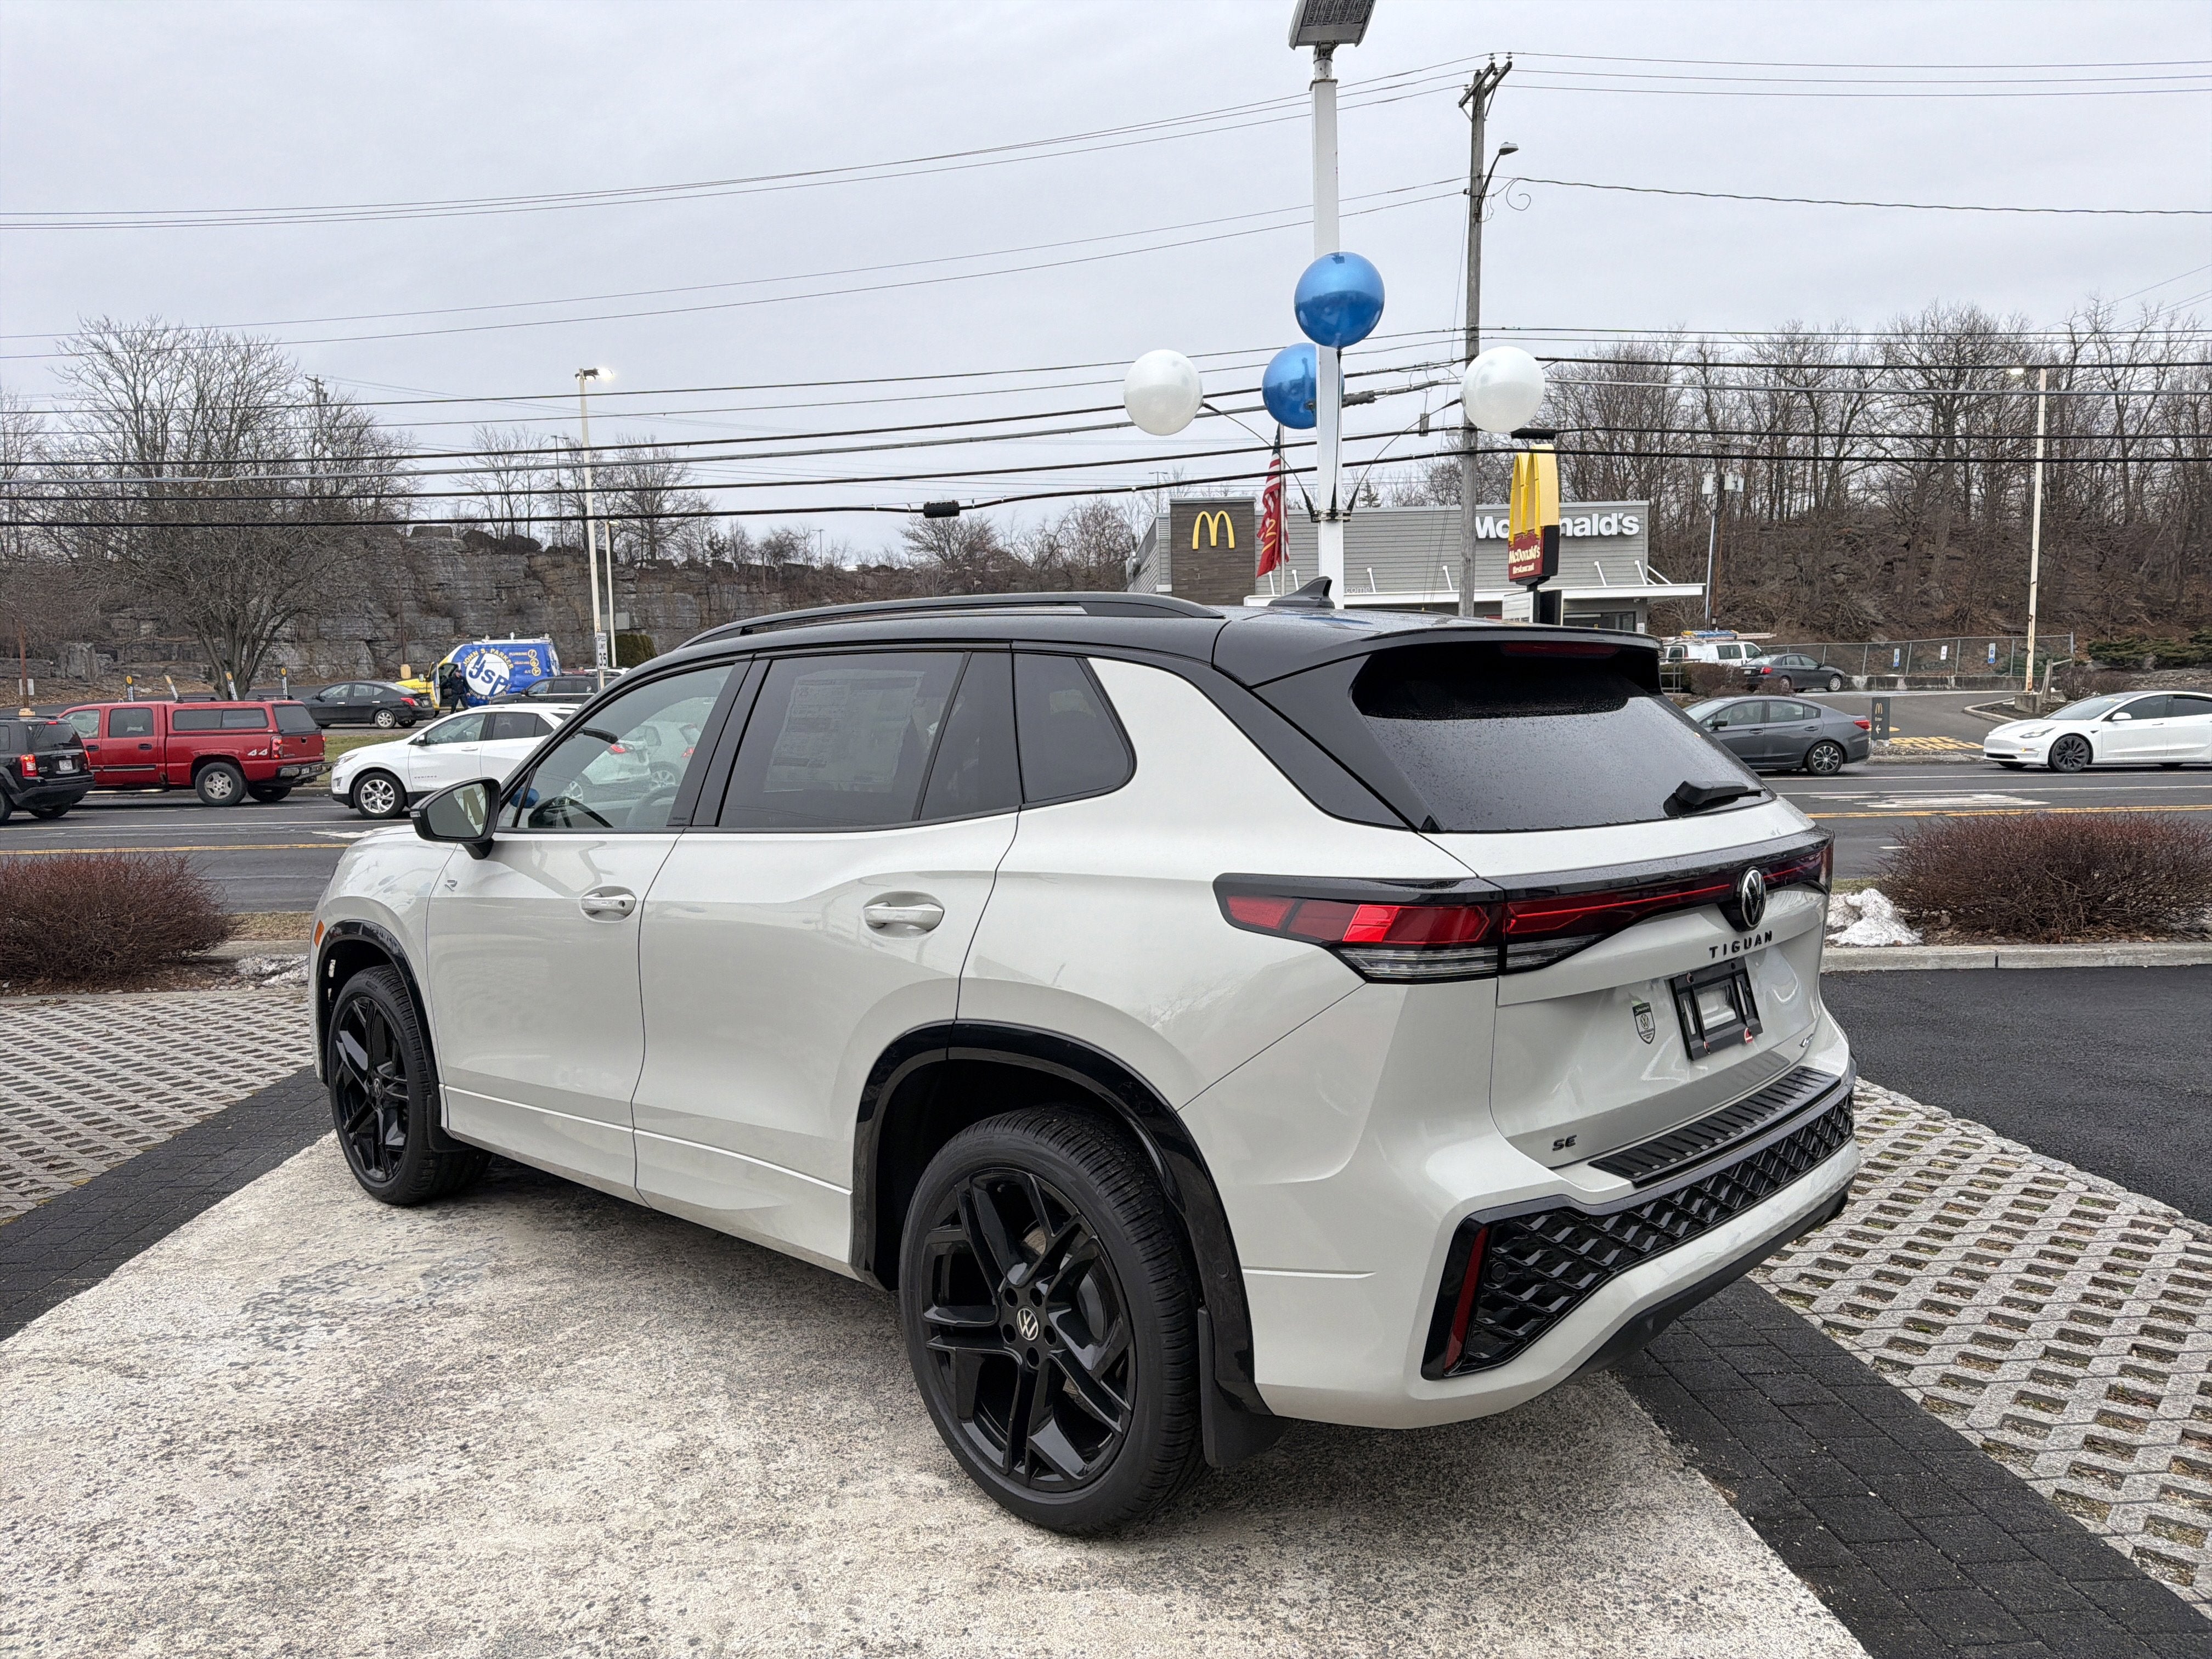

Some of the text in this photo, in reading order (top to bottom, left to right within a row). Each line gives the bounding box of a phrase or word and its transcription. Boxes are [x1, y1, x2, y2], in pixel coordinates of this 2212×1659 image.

[1476, 513, 1639, 538] Mcnald's
[1509, 545, 1541, 564] McDonald's
[463, 650, 479, 667] JOHN
[490, 648, 514, 669] PARKER
[599, 652, 607, 667] 35
[1709, 930, 1772, 959] TIGUAN
[1553, 1135, 1577, 1151] SE
